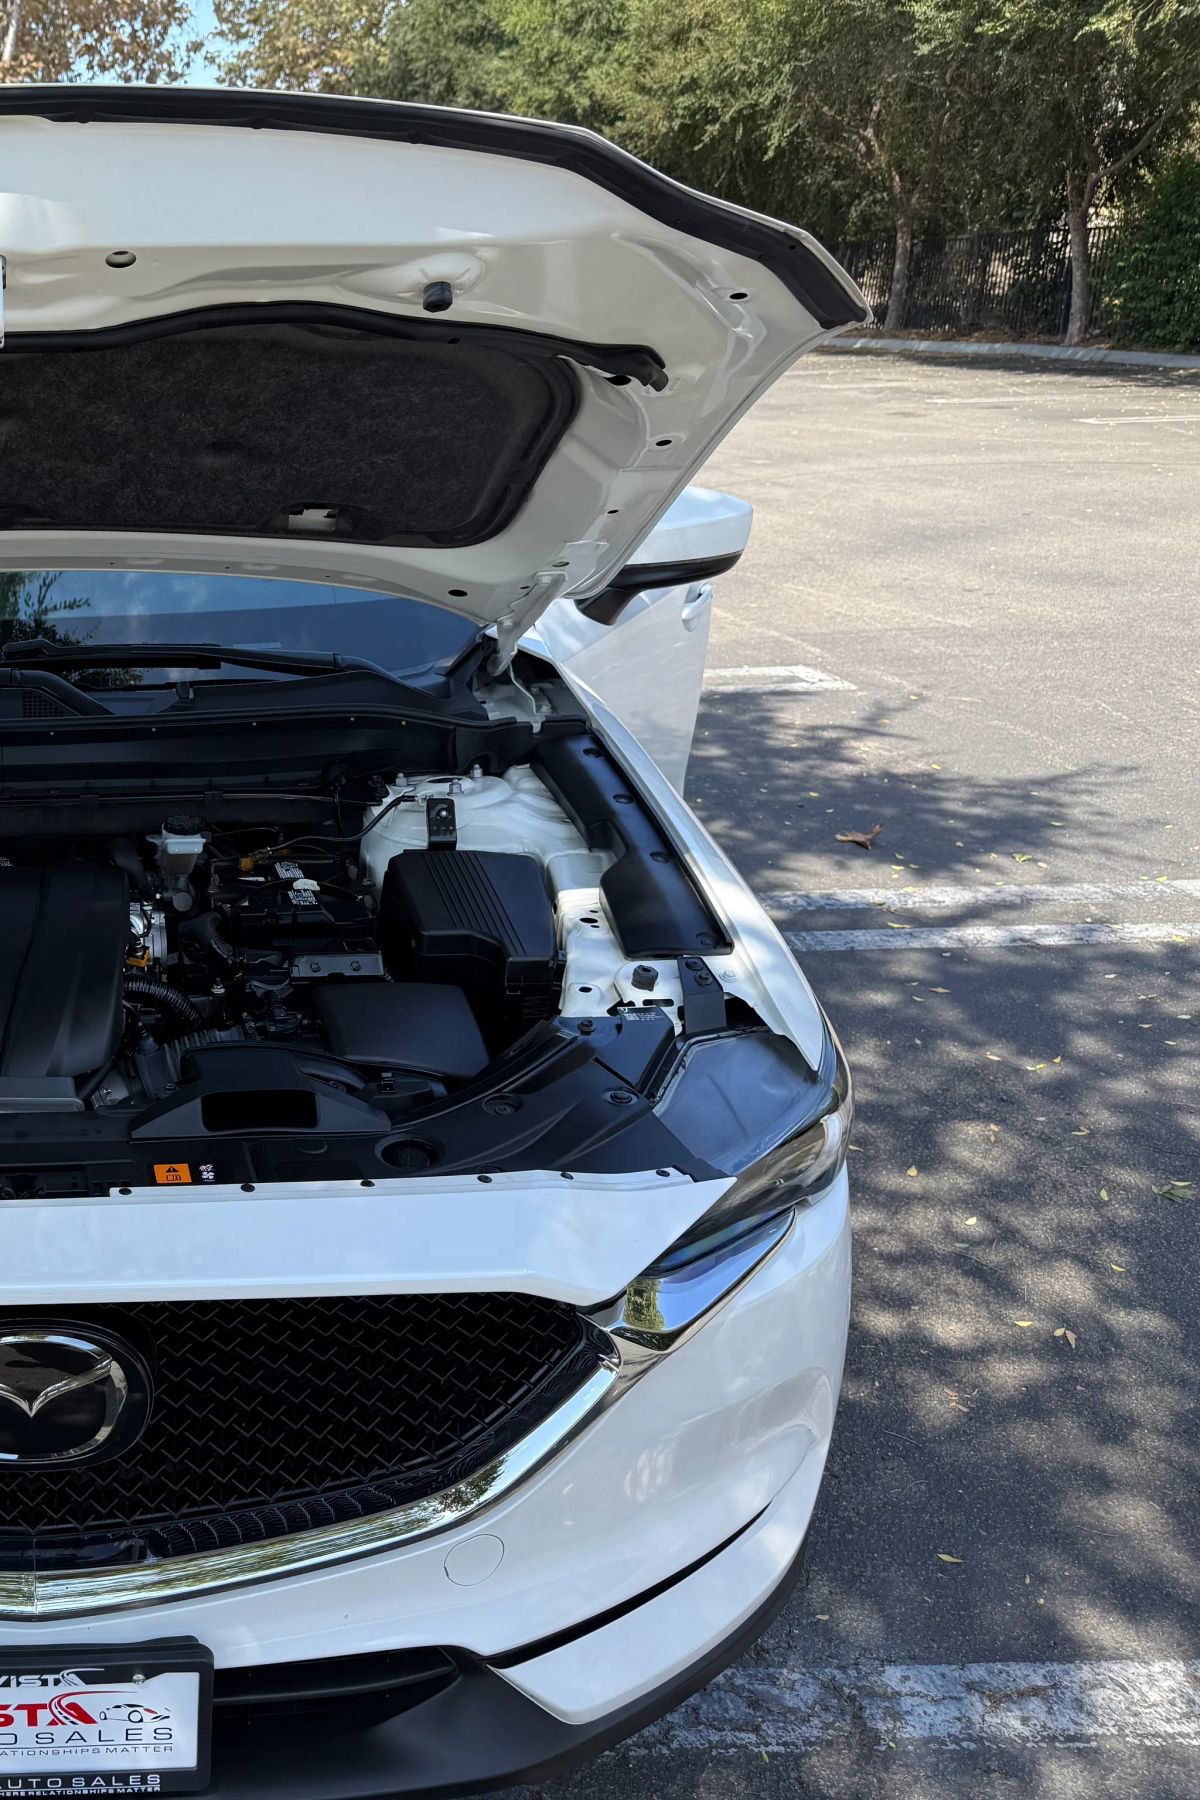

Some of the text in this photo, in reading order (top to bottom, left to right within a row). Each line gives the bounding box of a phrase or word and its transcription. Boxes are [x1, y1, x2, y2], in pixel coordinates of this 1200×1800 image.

[35, 1727, 174, 1745] SALES
[105, 1745, 174, 1754] MATTER
[72, 1774, 161, 1787] SALES
